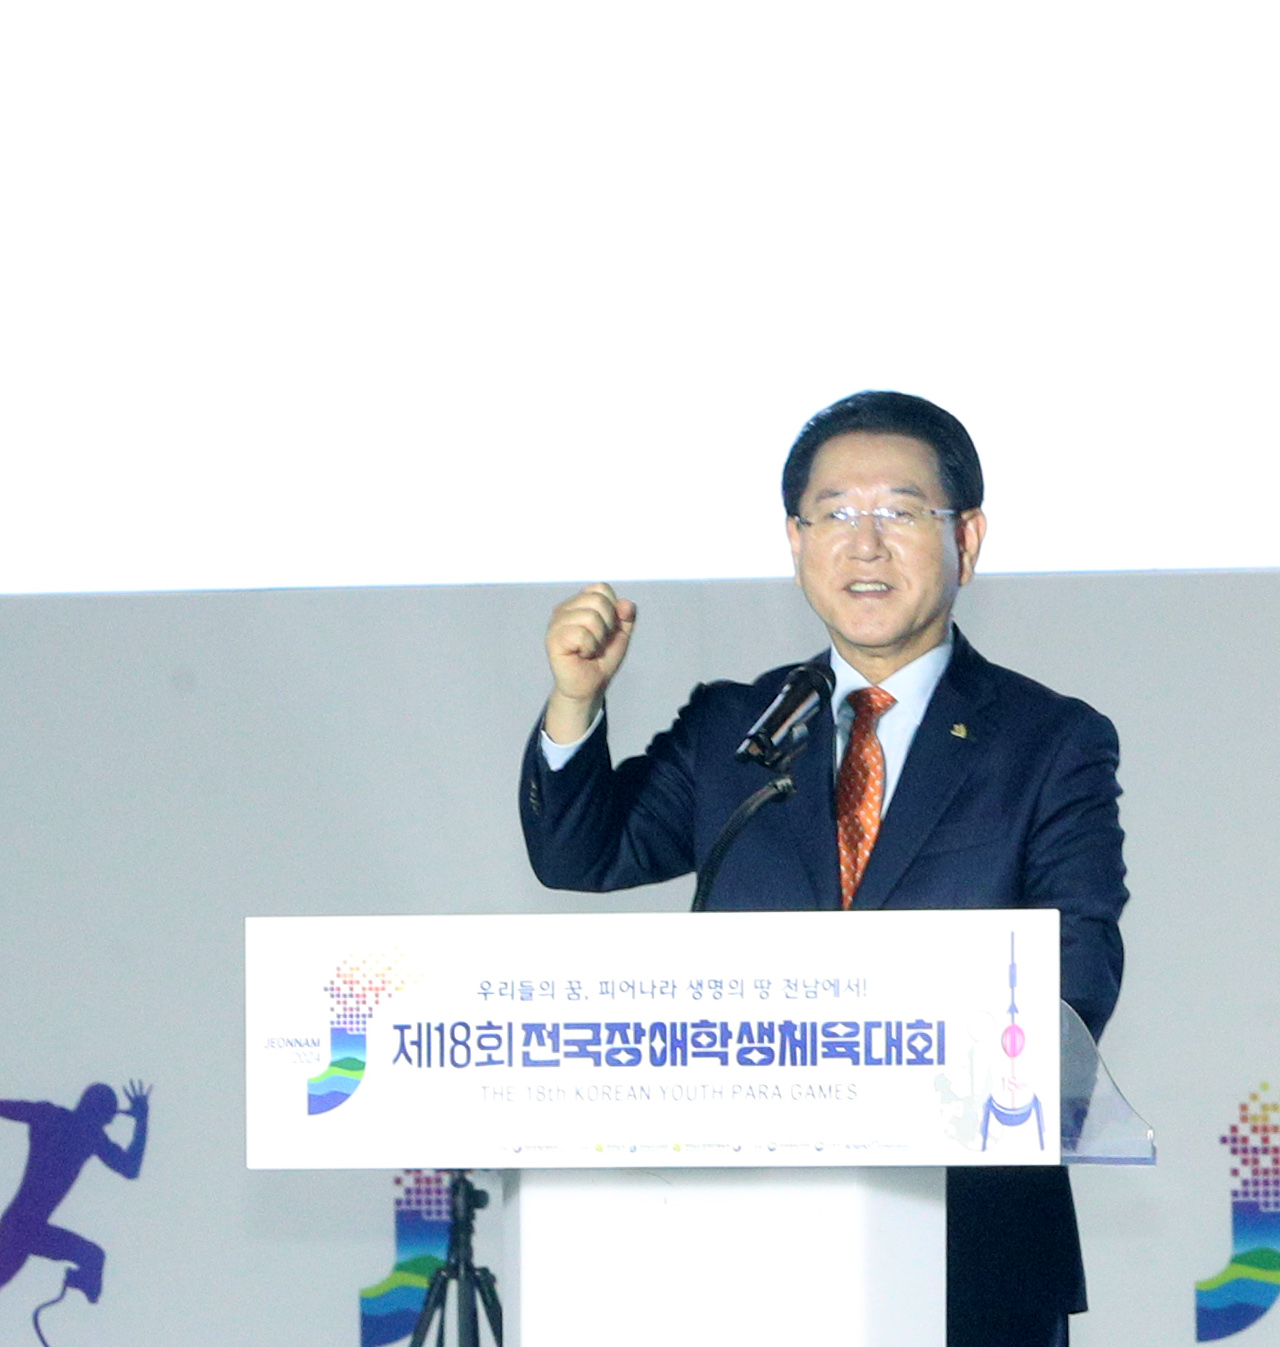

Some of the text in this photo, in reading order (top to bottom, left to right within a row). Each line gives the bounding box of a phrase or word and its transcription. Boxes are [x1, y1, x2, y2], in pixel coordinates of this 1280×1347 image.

[476, 977, 867, 1002] 우리들의 꿈, 피어나라 생명의 땅 전남에서!
[264, 1037, 321, 1049] JEONNAM
[392, 1018, 946, 1069] 제18회 전국장애학생체육대회
[480, 1082, 859, 1102] THE 18th KOREAN YOUTH PARA GAMES
